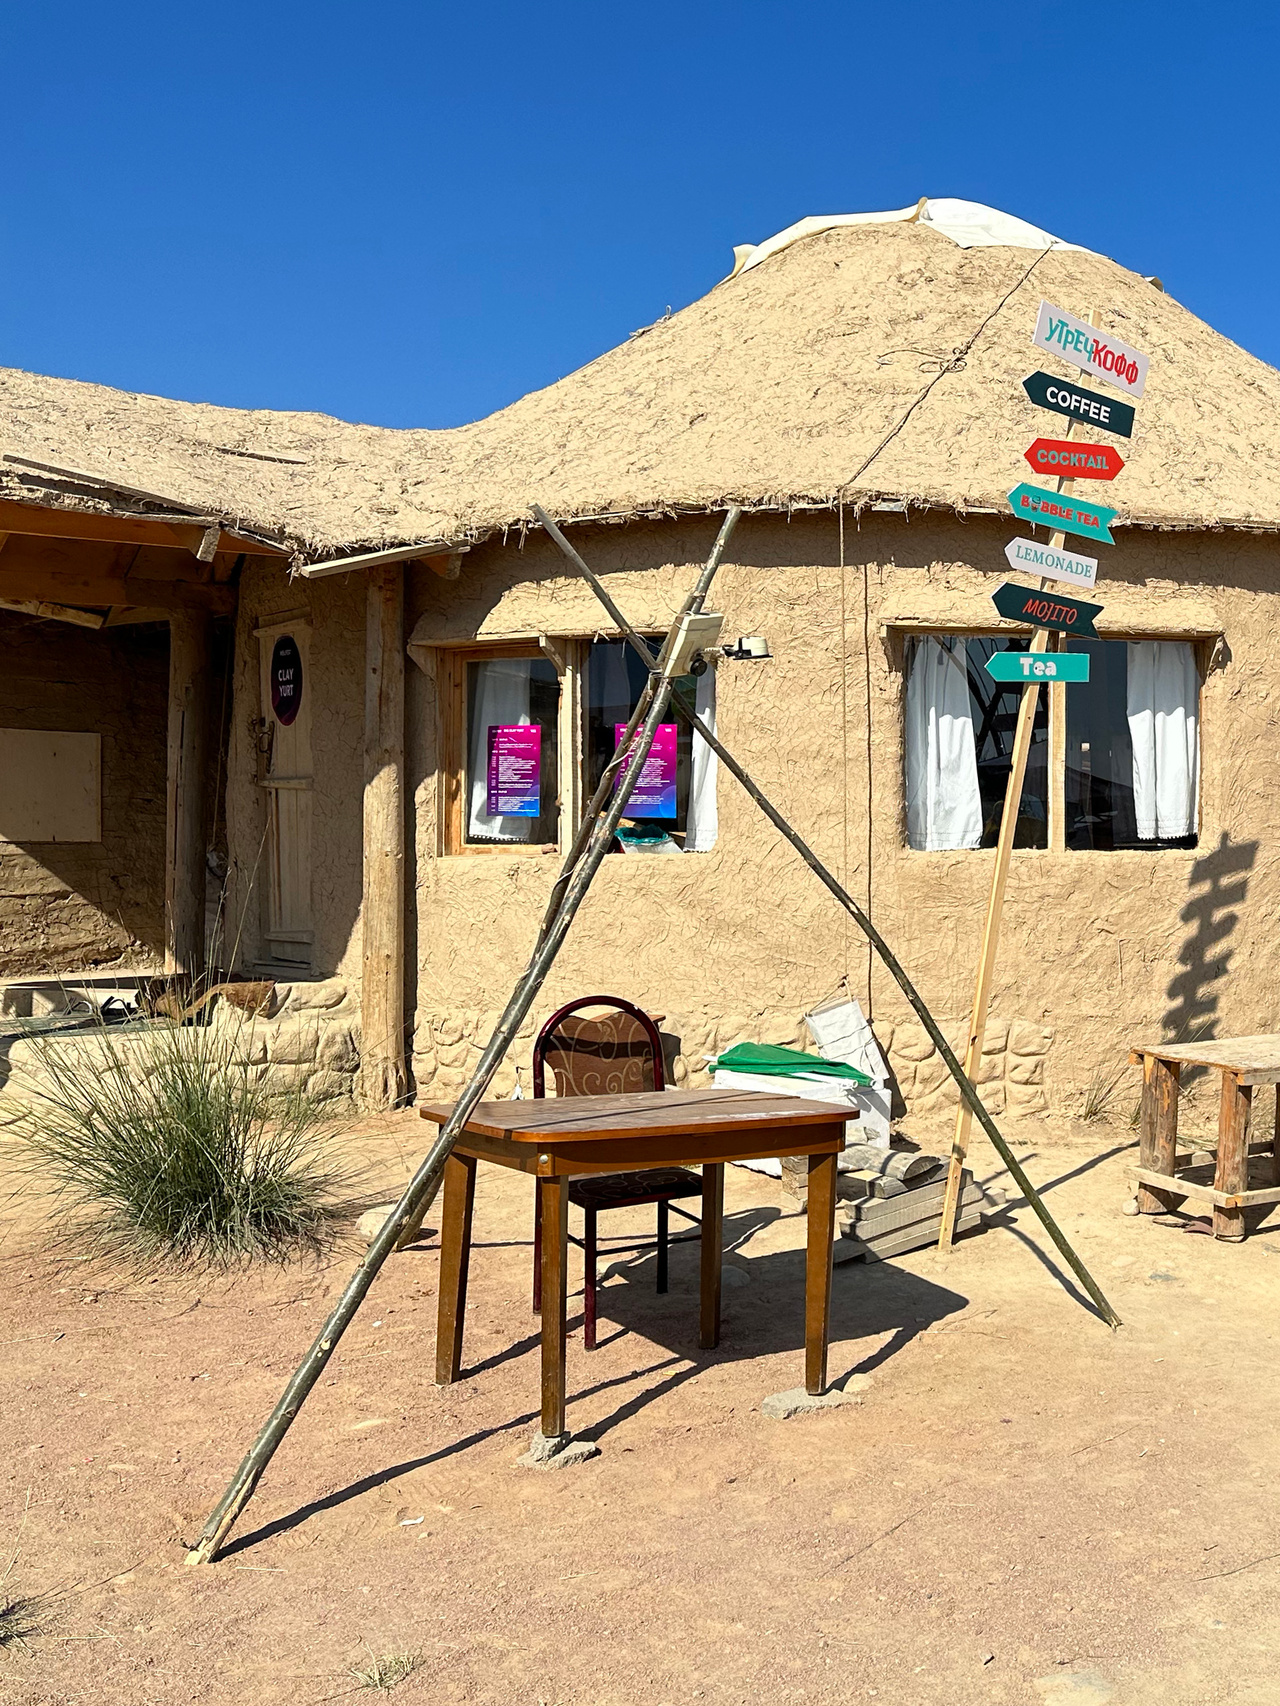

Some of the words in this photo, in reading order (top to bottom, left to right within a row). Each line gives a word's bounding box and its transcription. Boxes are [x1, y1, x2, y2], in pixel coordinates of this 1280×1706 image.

[1046, 386, 1111, 423] COFFEE
[1037, 449, 1109, 470] COCKTAIL
[1021, 495, 1073, 520] BBBLE
[1076, 511, 1100, 528] TEA
[1015, 545, 1093, 578] LEMONADE
[1022, 598, 1078, 625] MOJITO
[278, 668, 294, 681] CLAY
[1020, 657, 1057, 676] Tea
[278, 684, 294, 697] YURT
